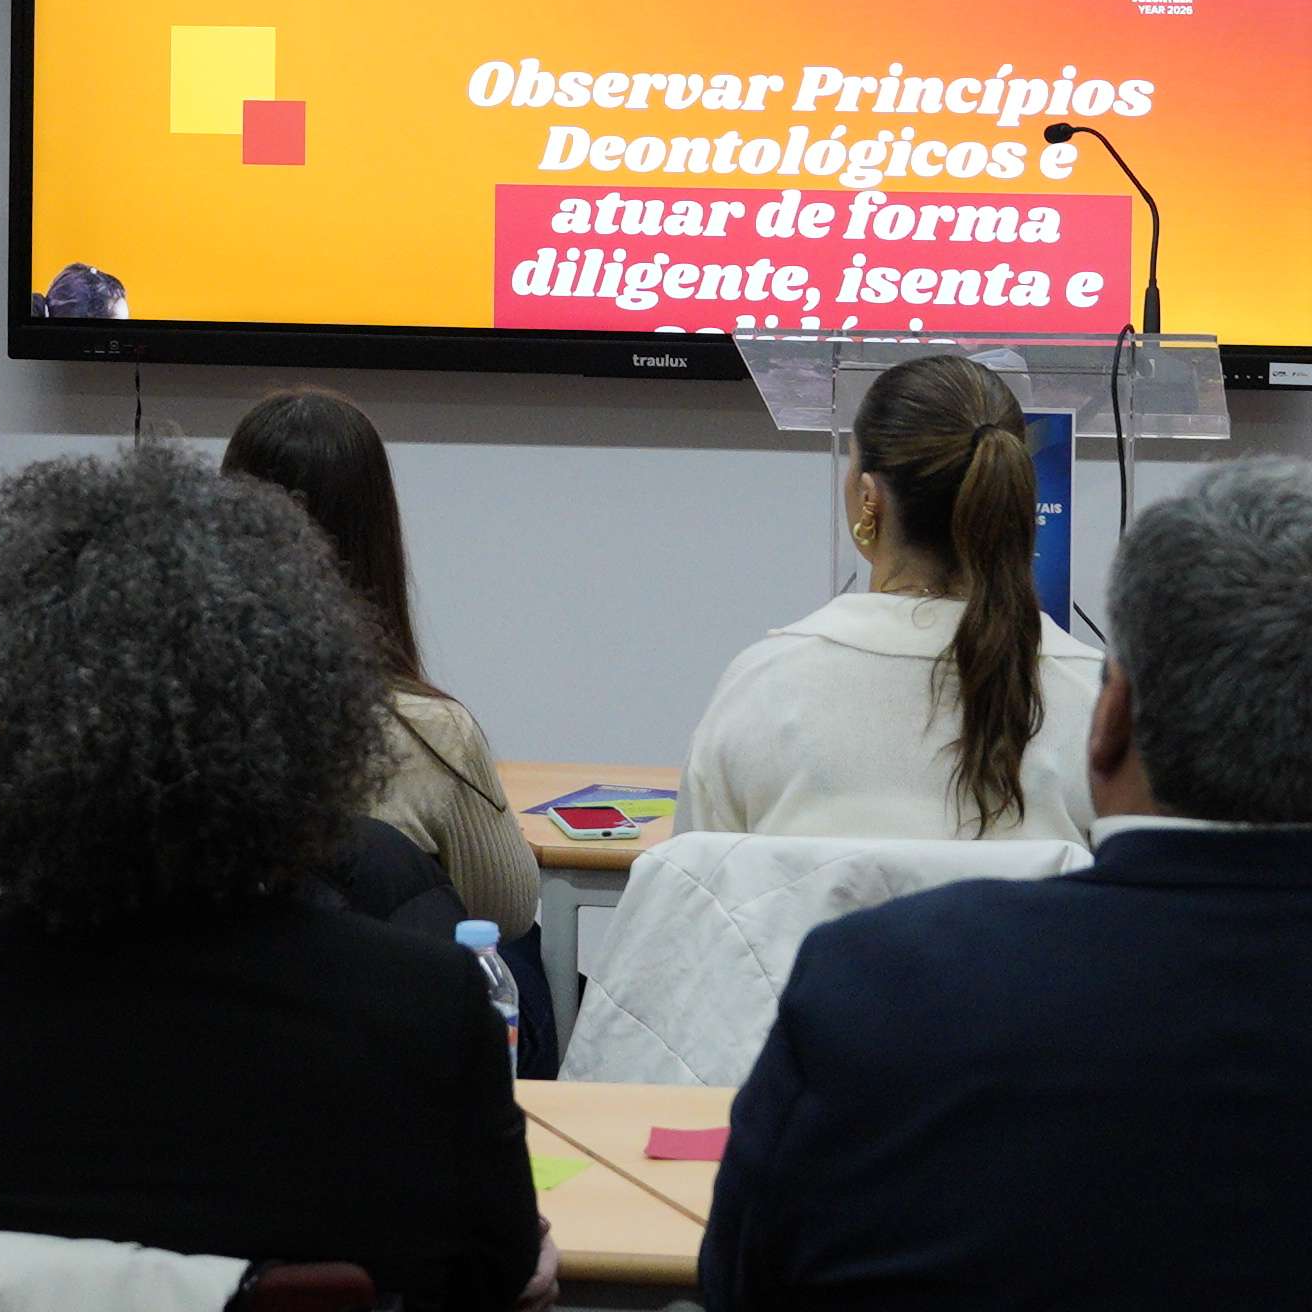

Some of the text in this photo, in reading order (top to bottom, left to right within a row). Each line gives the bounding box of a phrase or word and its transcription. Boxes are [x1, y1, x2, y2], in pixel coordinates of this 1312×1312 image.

[1138, 5, 1194, 15] YEAR 2026
[468, 57, 1156, 128] Observar Princípios
[537, 124, 1079, 190] Deontológicos e
[550, 188, 1062, 245] atuar de forma
[510, 246, 1105, 313] diligente, isenta e
[632, 353, 688, 368] traulux
